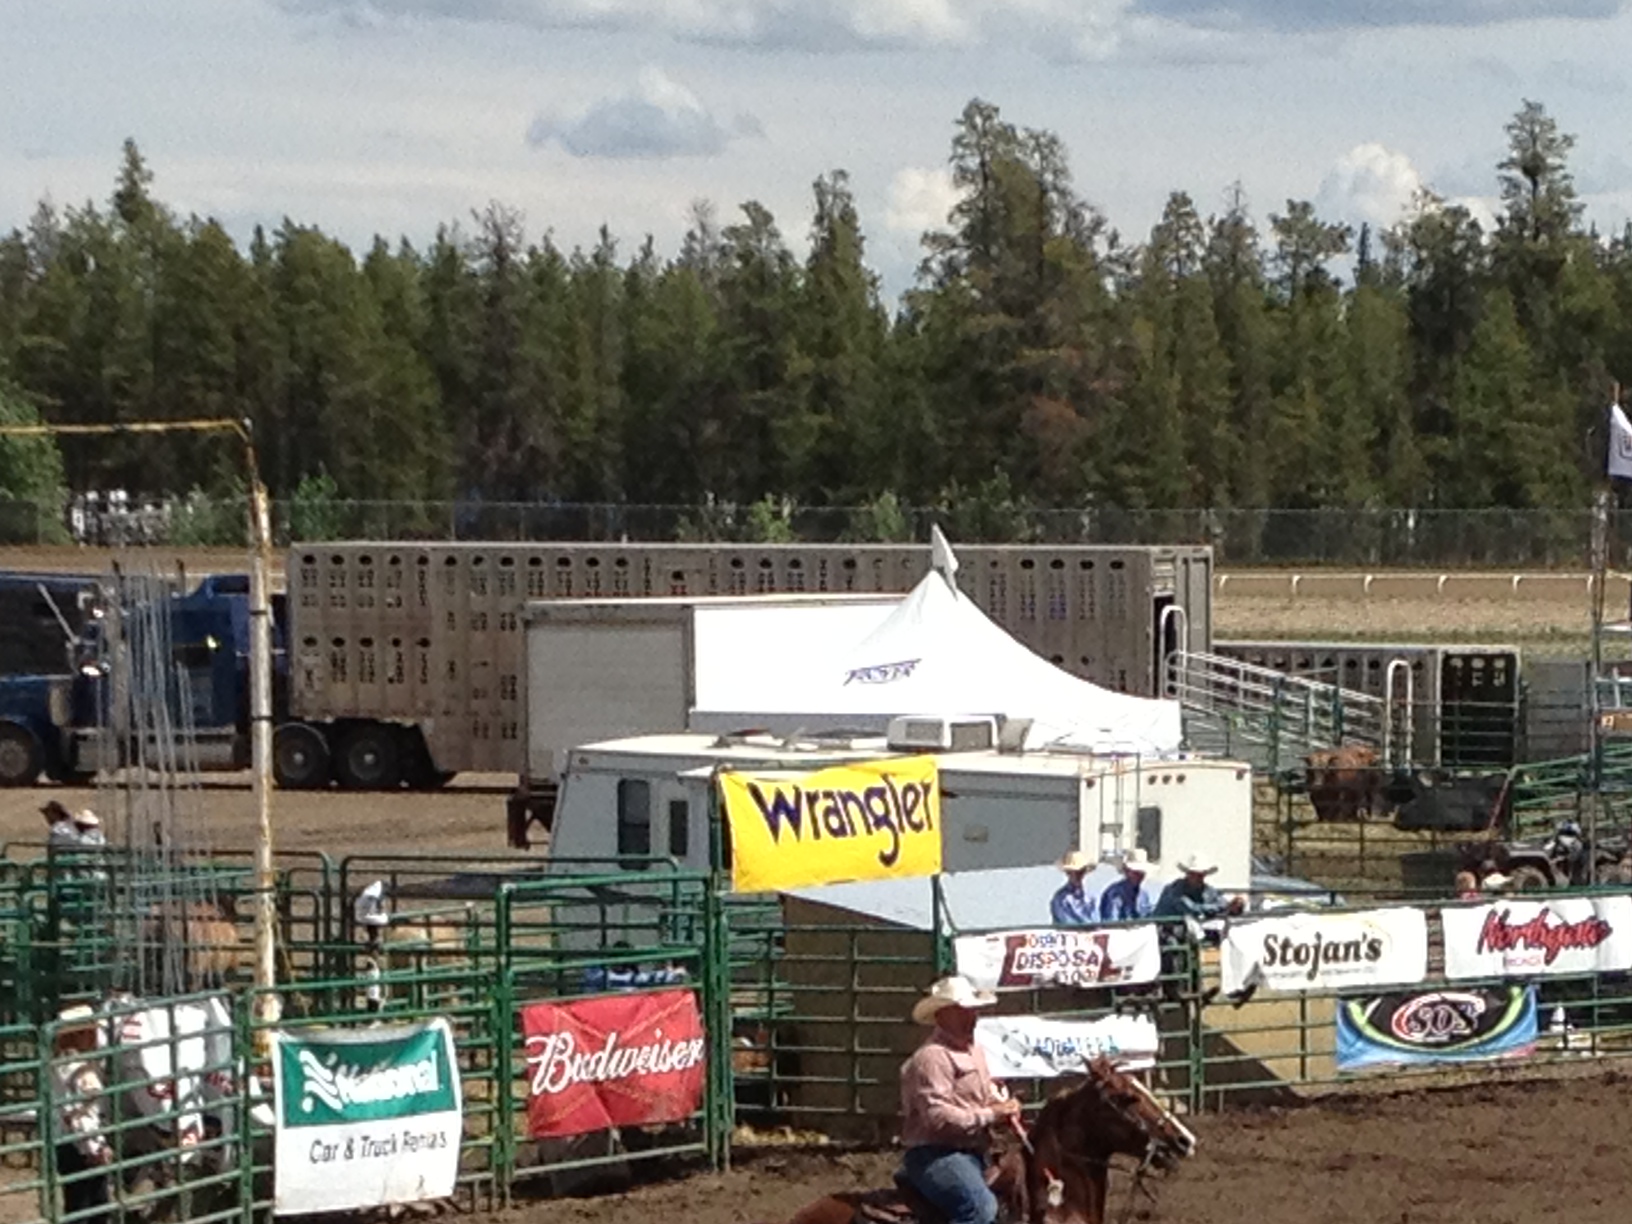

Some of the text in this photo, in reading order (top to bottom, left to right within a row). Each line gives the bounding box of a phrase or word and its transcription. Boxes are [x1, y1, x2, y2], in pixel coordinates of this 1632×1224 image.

[746, 773, 934, 867] Wrangler
[1263, 931, 1383, 981] Stojan's
[525, 1027, 704, 1097] Budweiser
[309, 1138, 338, 1164] Car
[344, 1136, 354, 1160] &
[360, 1133, 398, 1159] Truck
